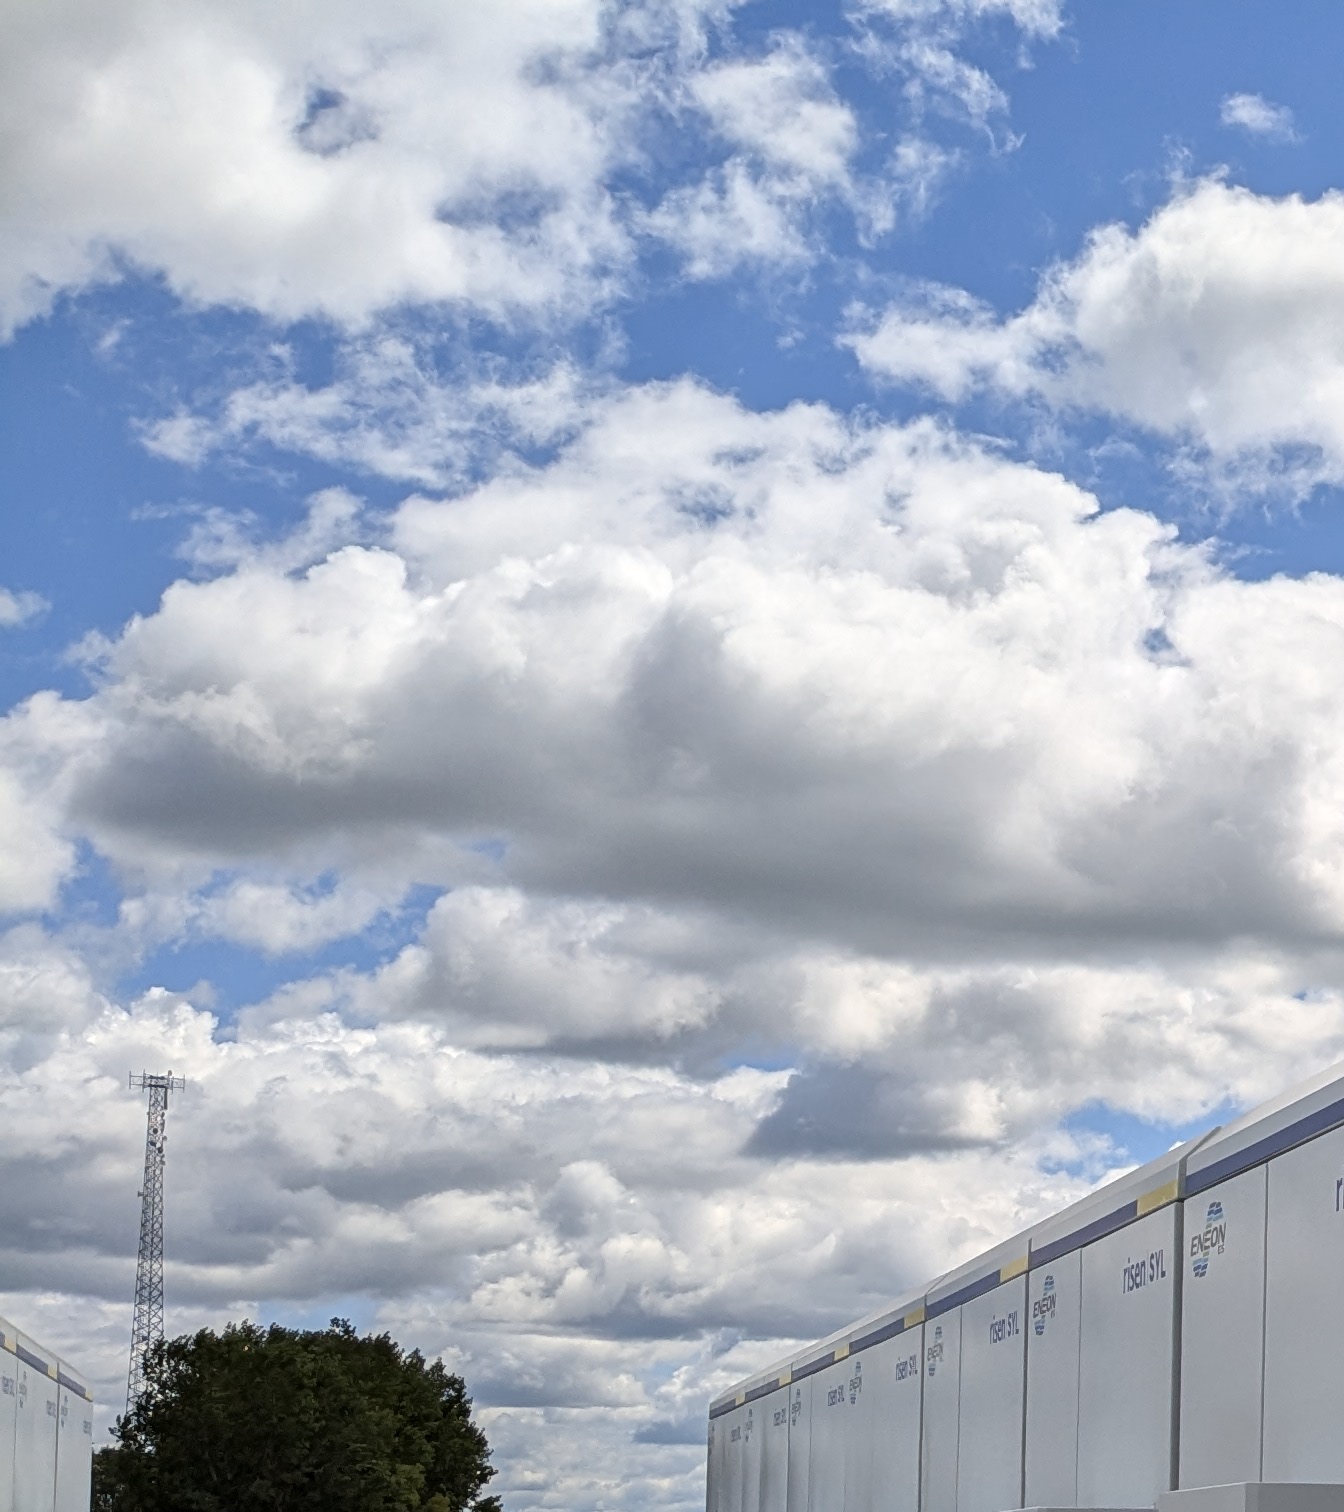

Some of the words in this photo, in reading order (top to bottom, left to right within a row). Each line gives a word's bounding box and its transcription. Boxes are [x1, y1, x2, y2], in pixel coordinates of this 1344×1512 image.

[1190, 1221, 1227, 1258] ENEON
[1123, 1257, 1146, 1294] risen
[1149, 1249, 1166, 1282] SYL
